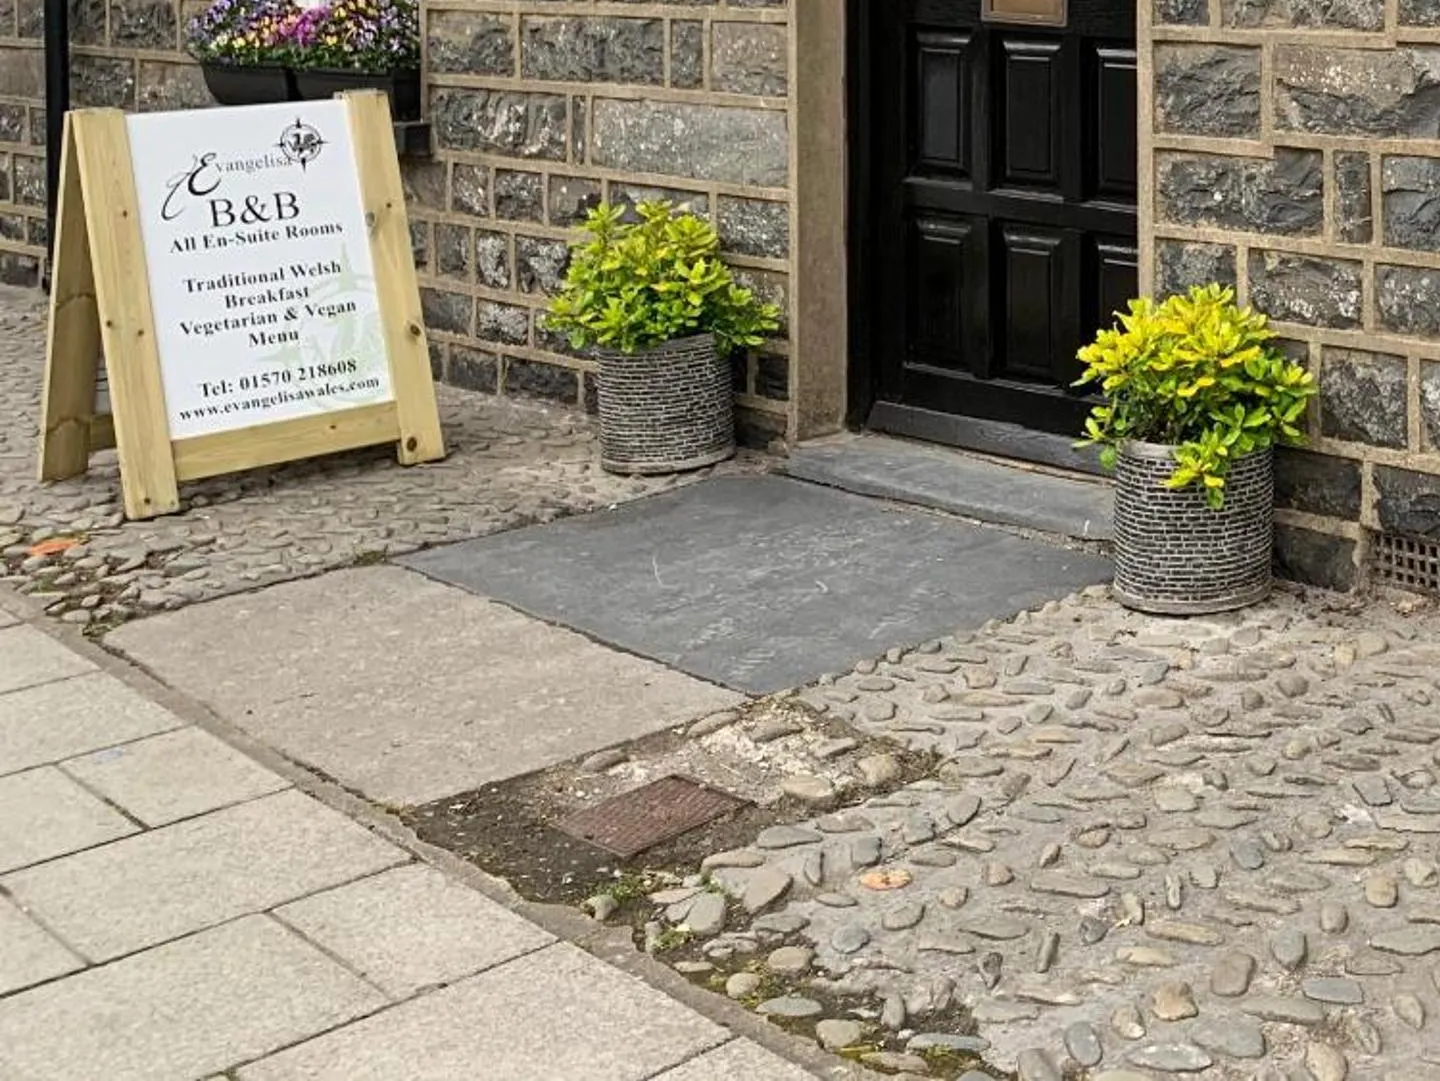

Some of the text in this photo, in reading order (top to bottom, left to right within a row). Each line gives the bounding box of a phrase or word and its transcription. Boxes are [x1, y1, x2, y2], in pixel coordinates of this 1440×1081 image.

[209, 191, 301, 228] B&B
[170, 221, 344, 254] All En-Suite Rooms
[183, 260, 342, 294] Traditional Welsh
[224, 287, 310, 310] Breakfast
[179, 300, 358, 337] Vegetarian & Vegan
[248, 331, 300, 349] Menu
[199, 359, 358, 399] Tel: 01570 218608
[178, 376, 380, 422] www.evangelisawales.com
